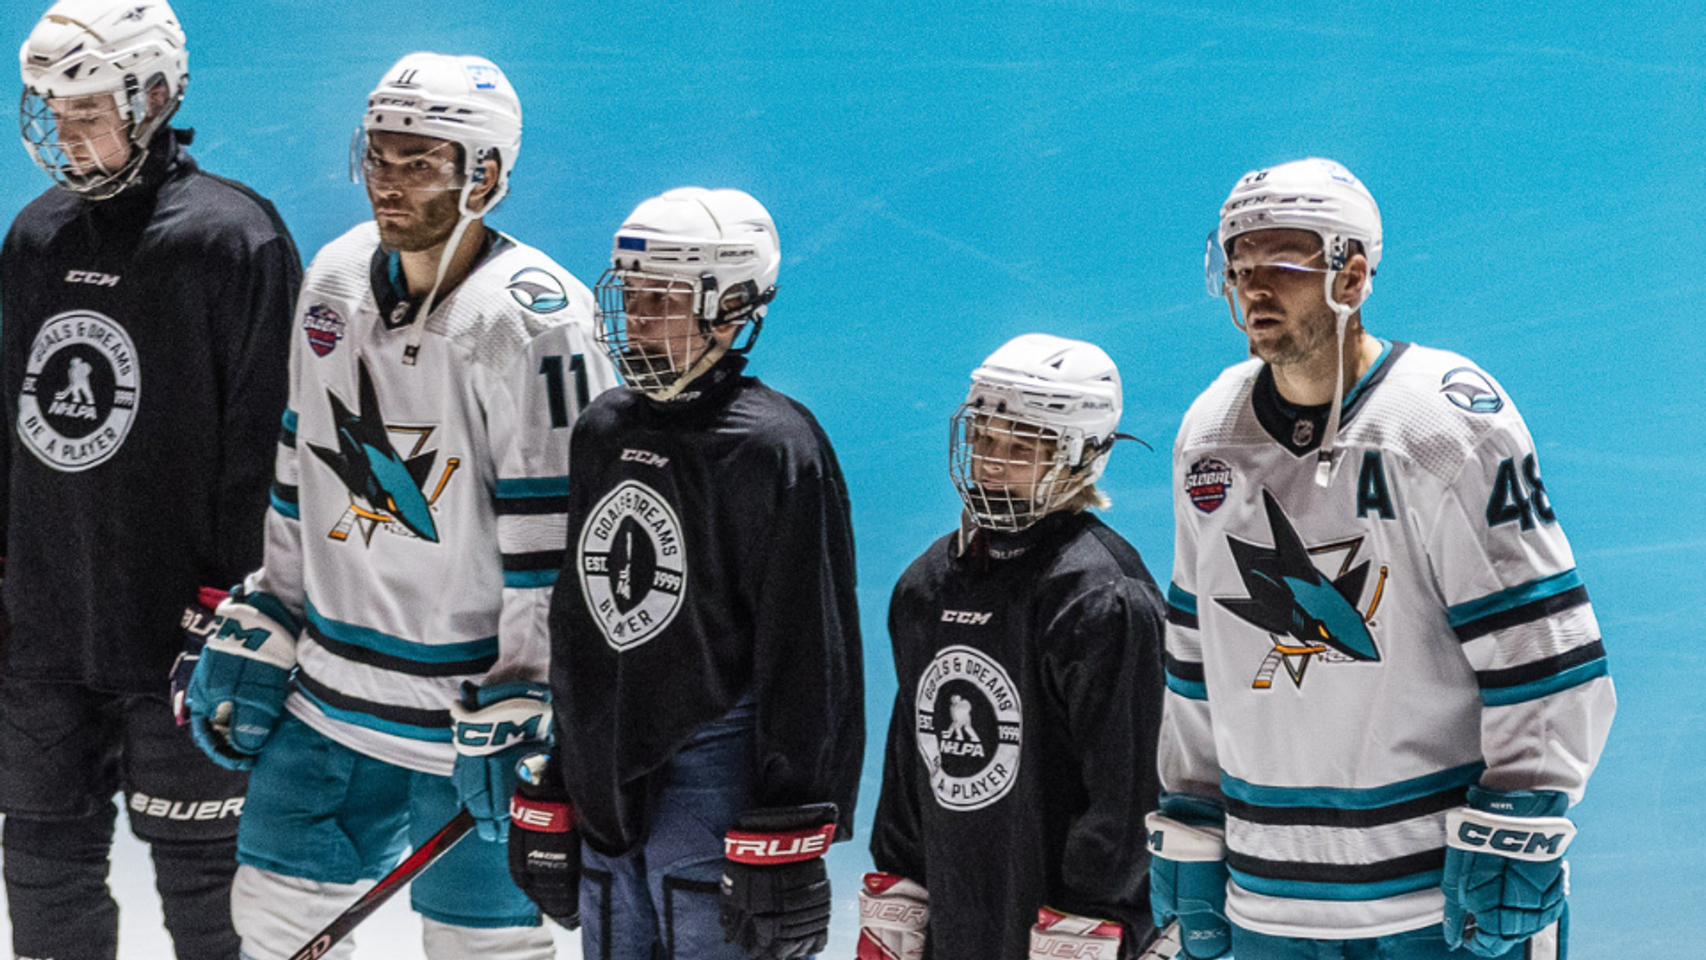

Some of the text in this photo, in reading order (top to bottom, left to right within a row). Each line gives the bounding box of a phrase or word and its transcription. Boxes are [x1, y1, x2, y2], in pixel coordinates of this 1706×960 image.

[64, 270, 120, 287] CCM
[539, 353, 590, 429] 11
[620, 448, 670, 468] CCM
[1357, 451, 1396, 519] A
[1486, 453, 1555, 532] 48
[653, 571, 681, 591] 1999
[941, 609, 993, 625] CCM
[966, 659, 1013, 712] DREAMS
[455, 713, 544, 747] CM
[941, 740, 985, 758] NHLPA
[951, 762, 1009, 800] PLAYER
[130, 792, 245, 820] BAUER
[724, 833, 827, 856] TRUE
[1458, 821, 1565, 854] CCM
